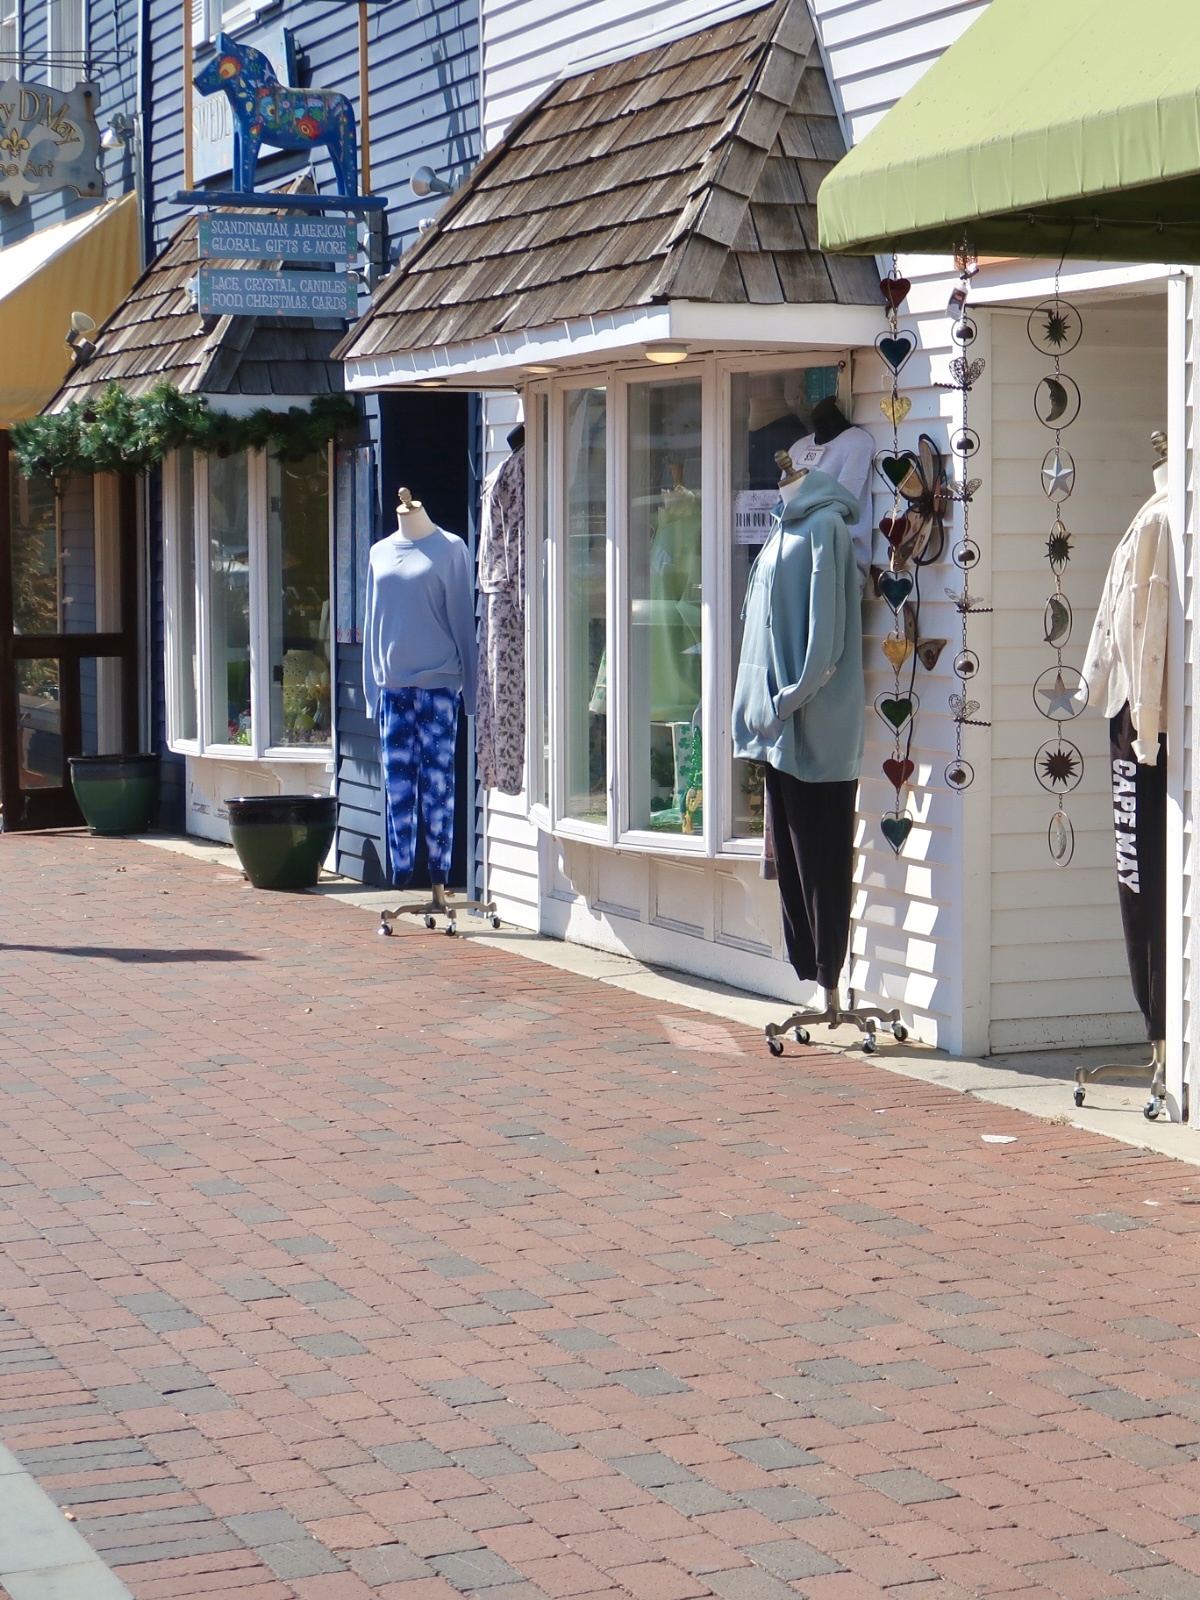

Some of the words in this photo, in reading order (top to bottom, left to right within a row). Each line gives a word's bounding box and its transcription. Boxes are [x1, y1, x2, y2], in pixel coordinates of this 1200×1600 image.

[22, 160, 54, 177] Art
[210, 220, 290, 238] SCANDINAVIAN,
[293, 223, 347, 239] AMERICAN
[211, 237, 261, 252] GLOBAL
[265, 239, 299, 254] GIFTS
[303, 240, 313, 253] &
[314, 241, 348, 255] MORE
[211, 276, 242, 291] LACE,
[244, 277, 298, 293] CRYSTAL,
[300, 279, 347, 294] CANDLES
[211, 293, 244, 308] FOOD,
[246, 294, 310, 310] CHRISTMAS,
[312, 296, 347, 311] CARDS
[735, 512, 751, 528] JOIN
[753, 512, 766, 528] OUR
[1113, 758, 1137, 828] CAPE
[1115, 829, 1140, 894] MAY
